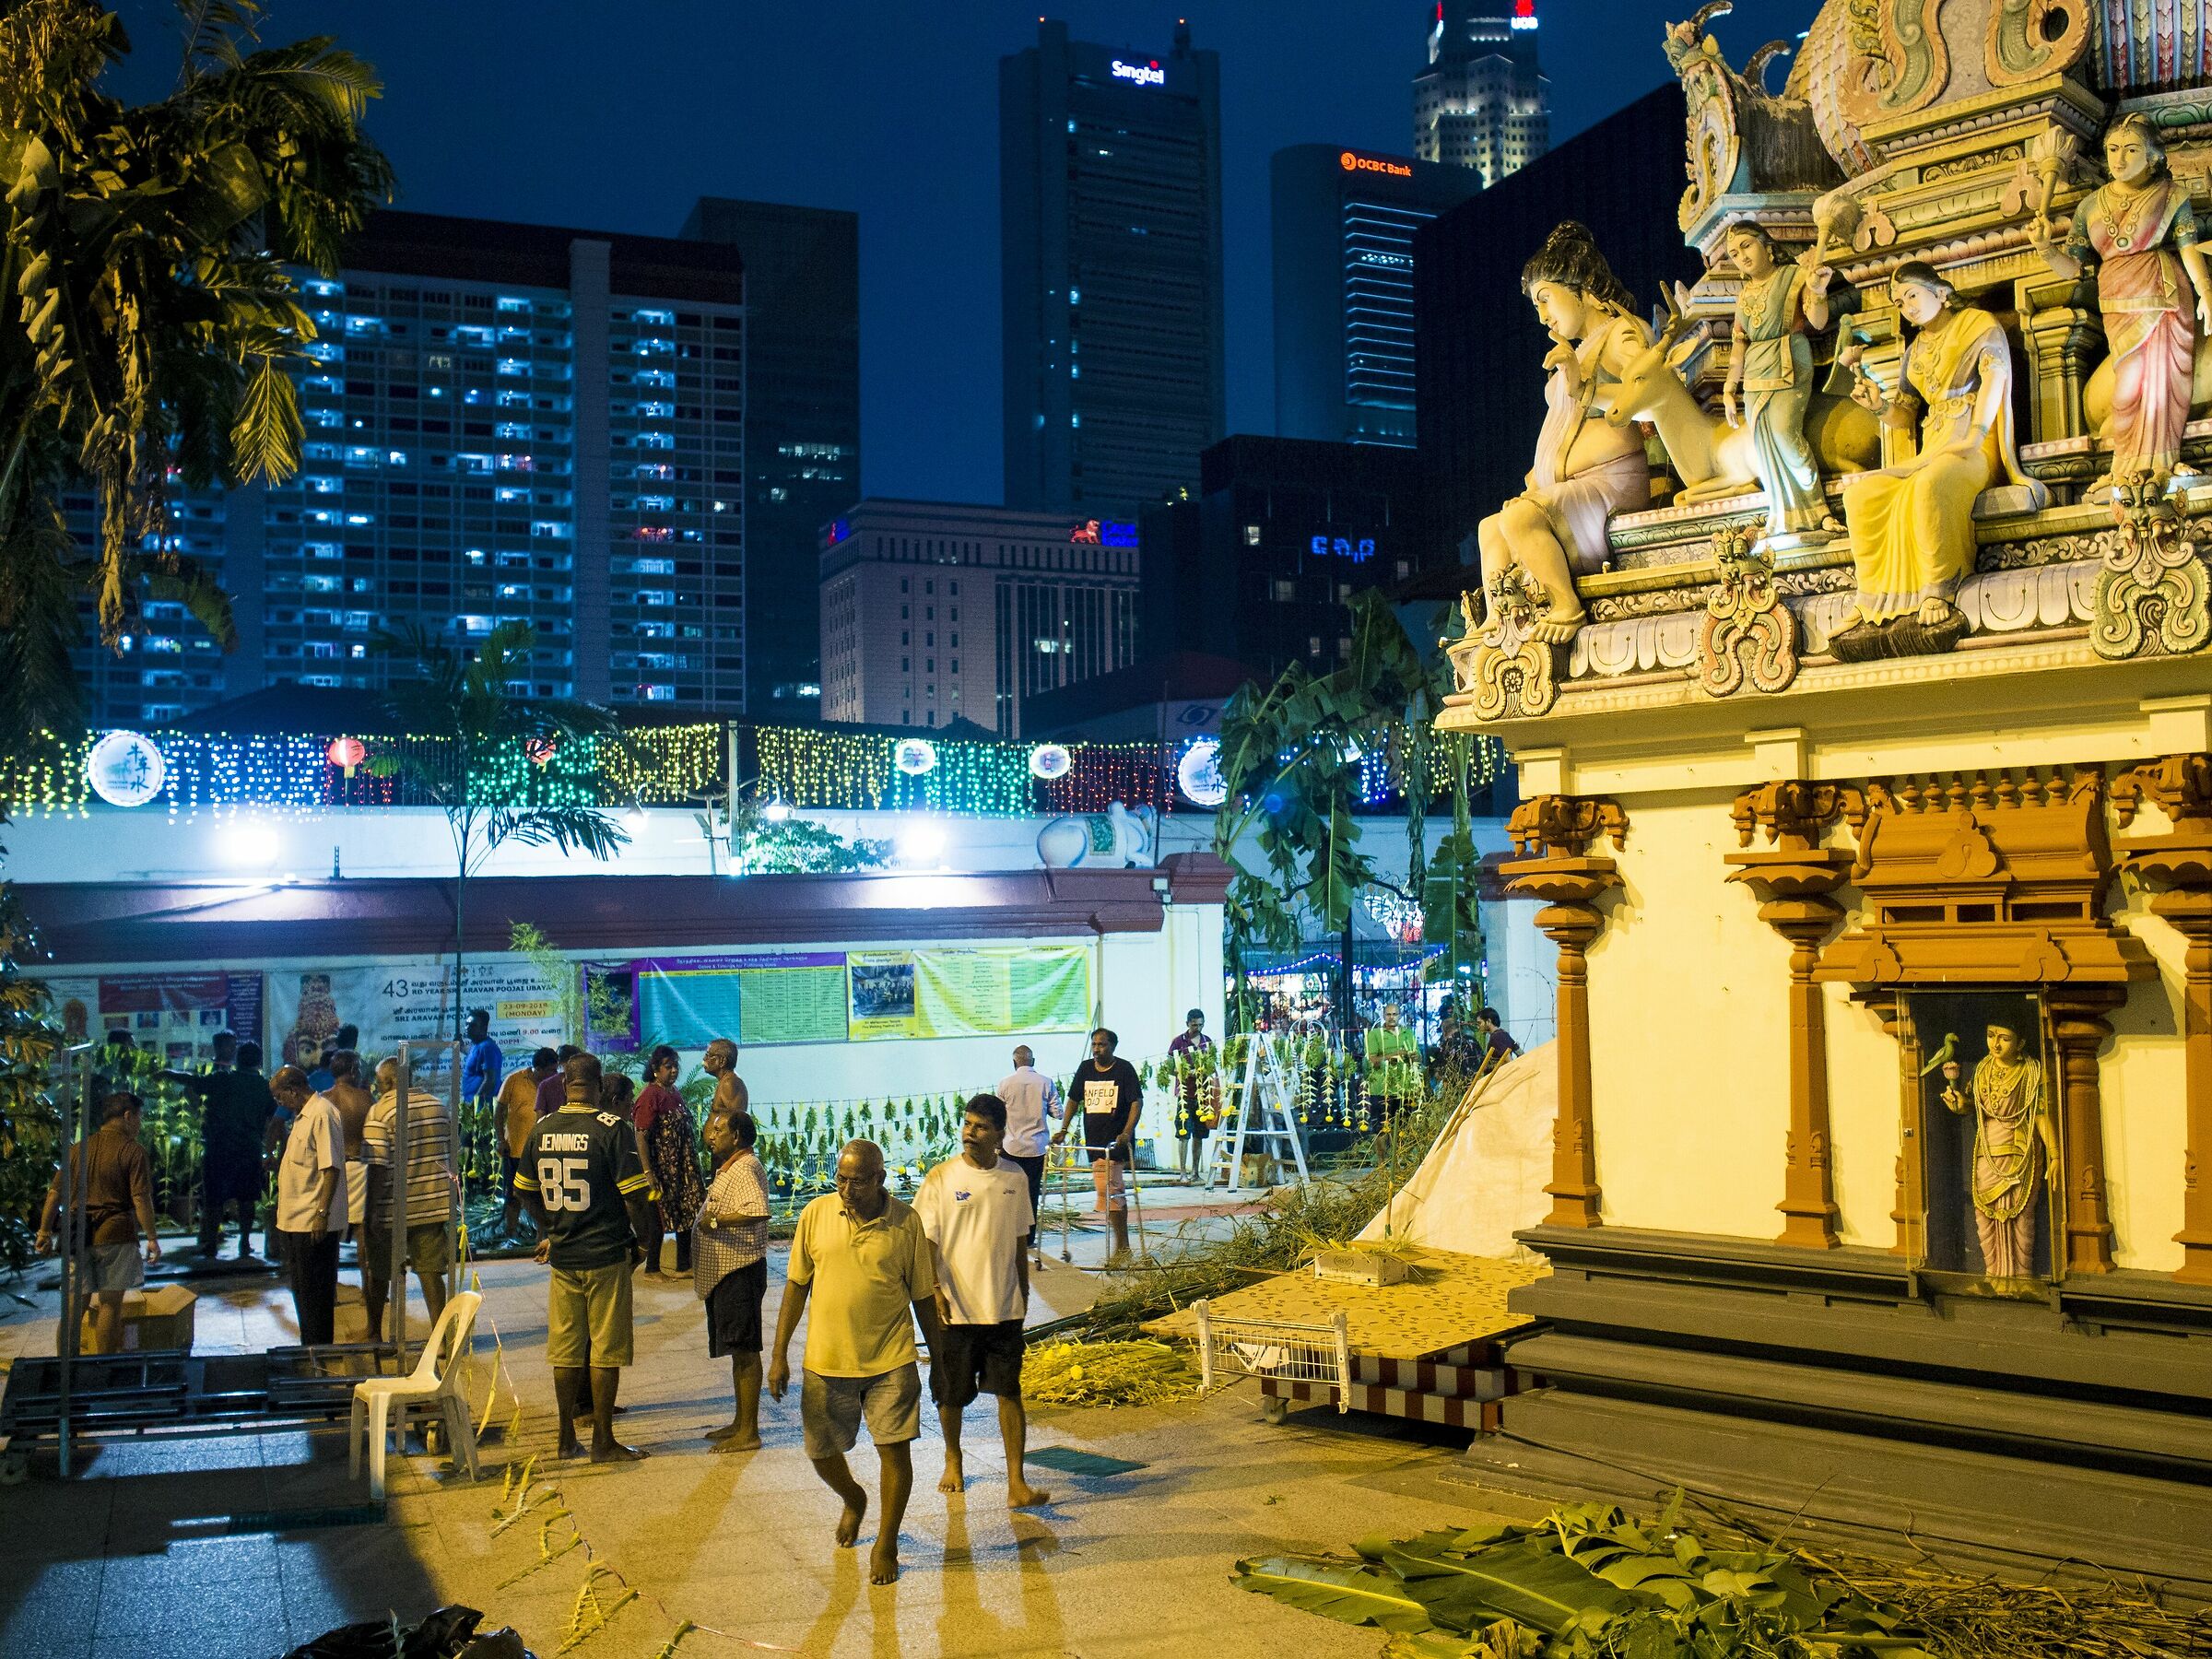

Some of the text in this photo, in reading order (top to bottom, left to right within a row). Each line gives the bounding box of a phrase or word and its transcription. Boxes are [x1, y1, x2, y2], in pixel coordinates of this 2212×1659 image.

[1112, 60, 1164, 85] Singtel
[1358, 159, 1412, 176] OCBC Bank
[382, 980, 408, 997] 43
[505, 1009, 547, 1018] (MONDAY)
[538, 1133, 589, 1152] JENNINGS
[537, 1158, 591, 1212] 85
